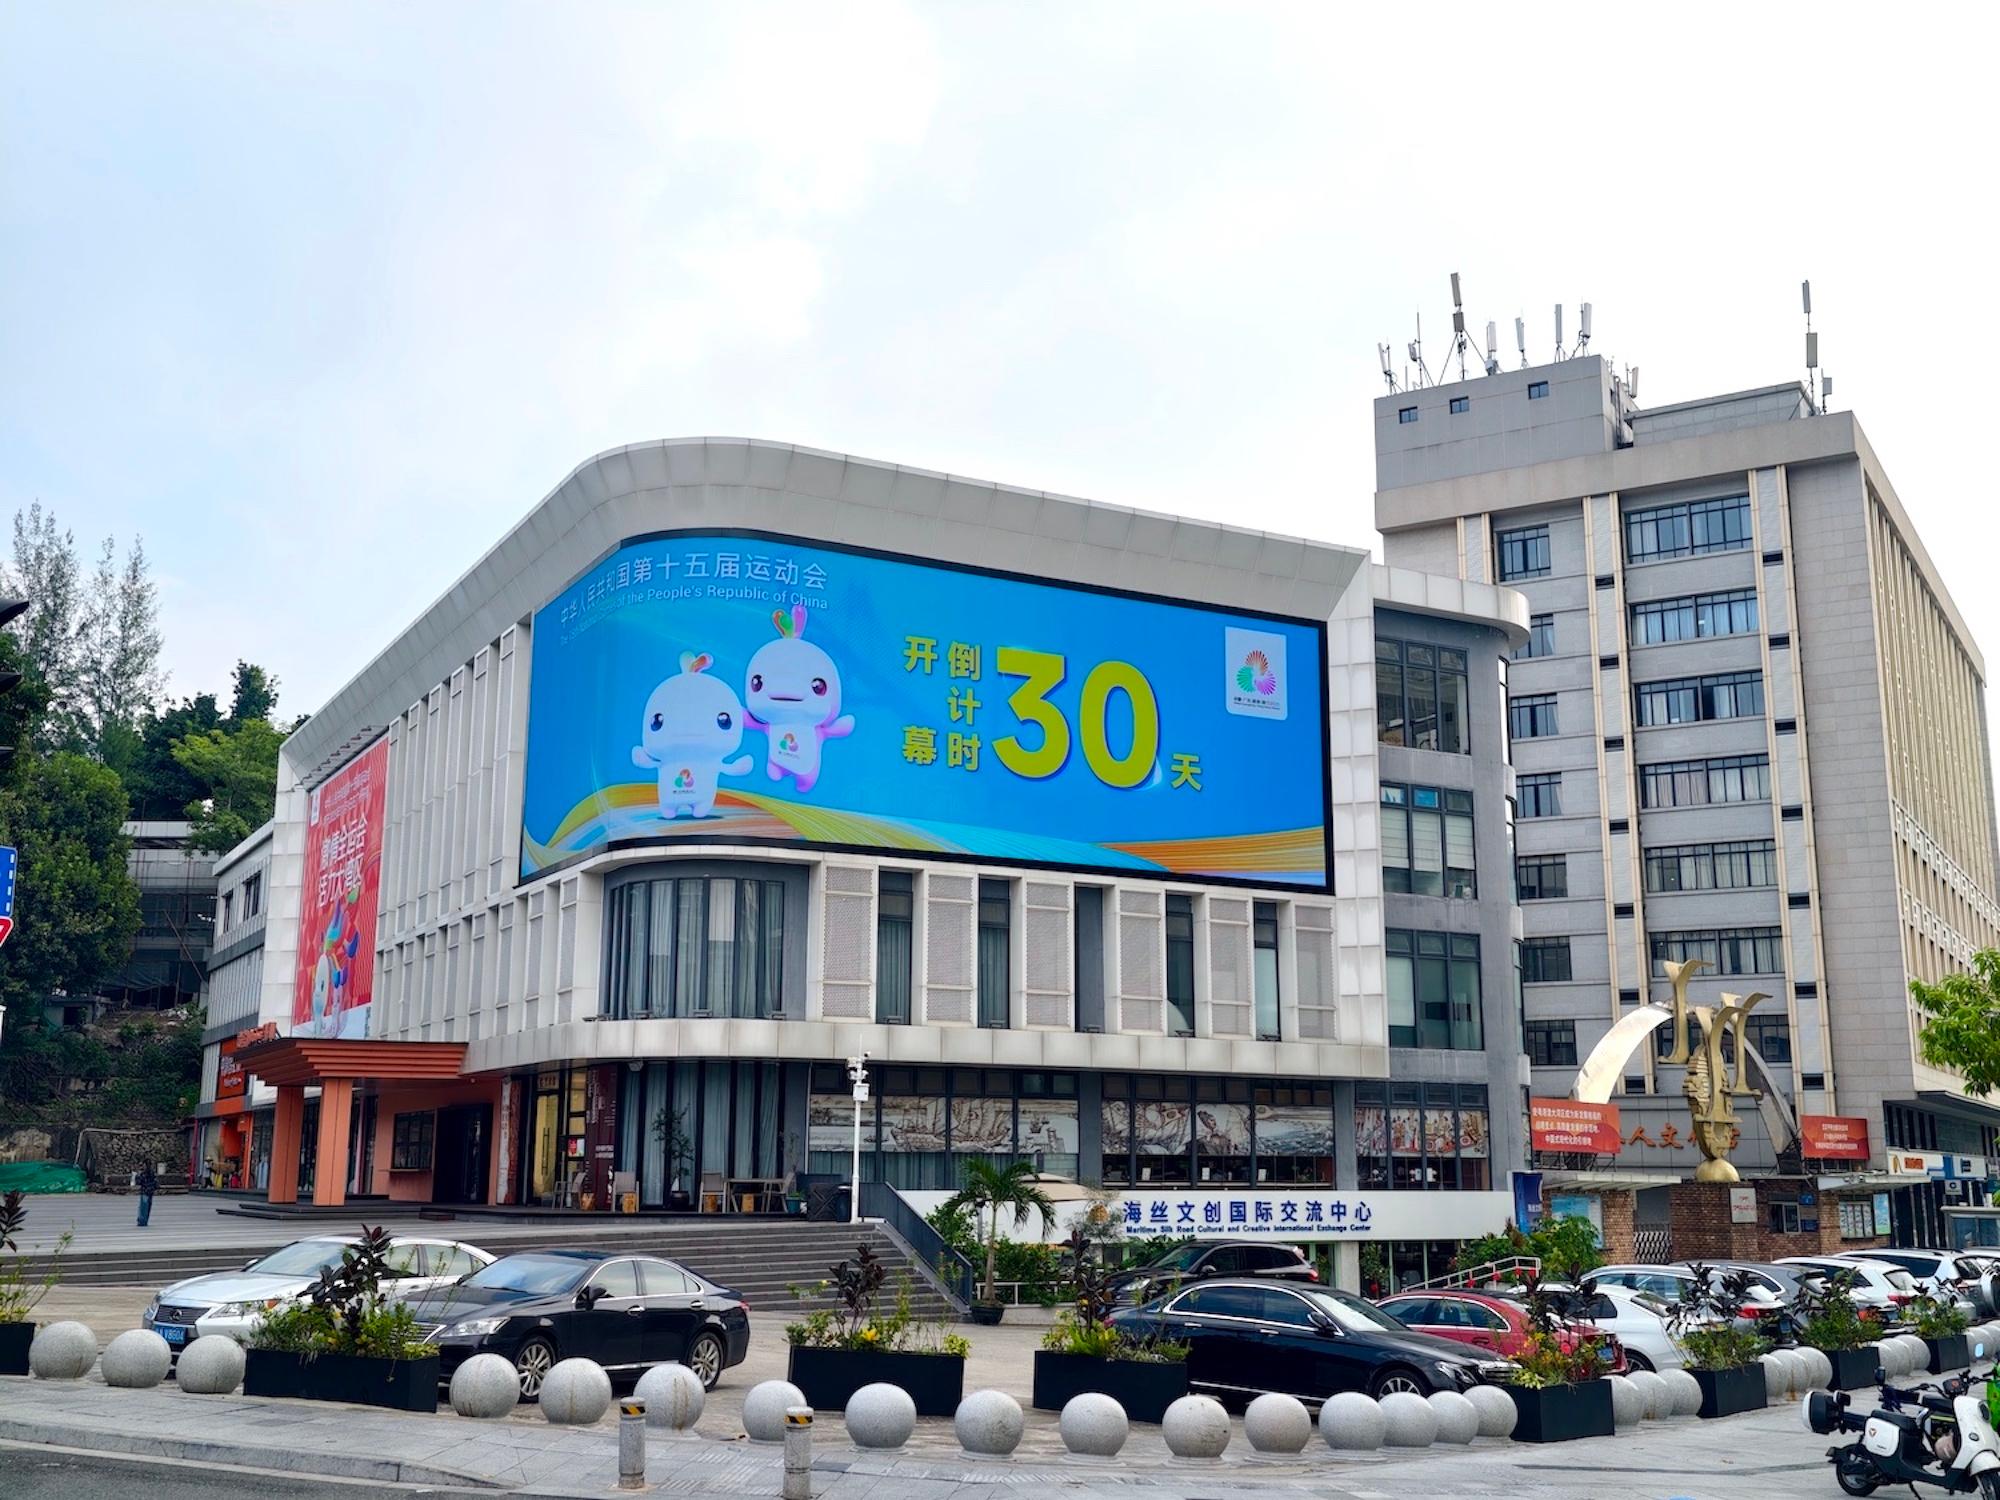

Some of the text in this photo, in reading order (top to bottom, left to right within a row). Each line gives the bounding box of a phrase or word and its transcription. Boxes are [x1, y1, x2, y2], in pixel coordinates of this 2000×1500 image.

[560, 552, 827, 629] 中华人民共和国第十五届运动会
[627, 591, 645, 605] the
[647, 585, 702, 601] People's
[707, 585, 770, 601] Republic
[773, 590, 787, 603] of
[790, 592, 828, 609] China
[947, 641, 982, 771] 倒计时
[992, 647, 1203, 791] 30 天
[1123, 1201, 1372, 1223] 海丝文创国际交流中心
[1126, 1225, 1157, 1233] Maritime
[1160, 1225, 1173, 1233] Silk
[1176, 1225, 1194, 1233] Road
[1197, 1225, 1224, 1233] Cultural
[1243, 1224, 1270, 1232] Creative
[1273, 1224, 1313, 1232] International
[1317, 1224, 1347, 1233] Exchange
[1350, 1224, 1371, 1232] Center
